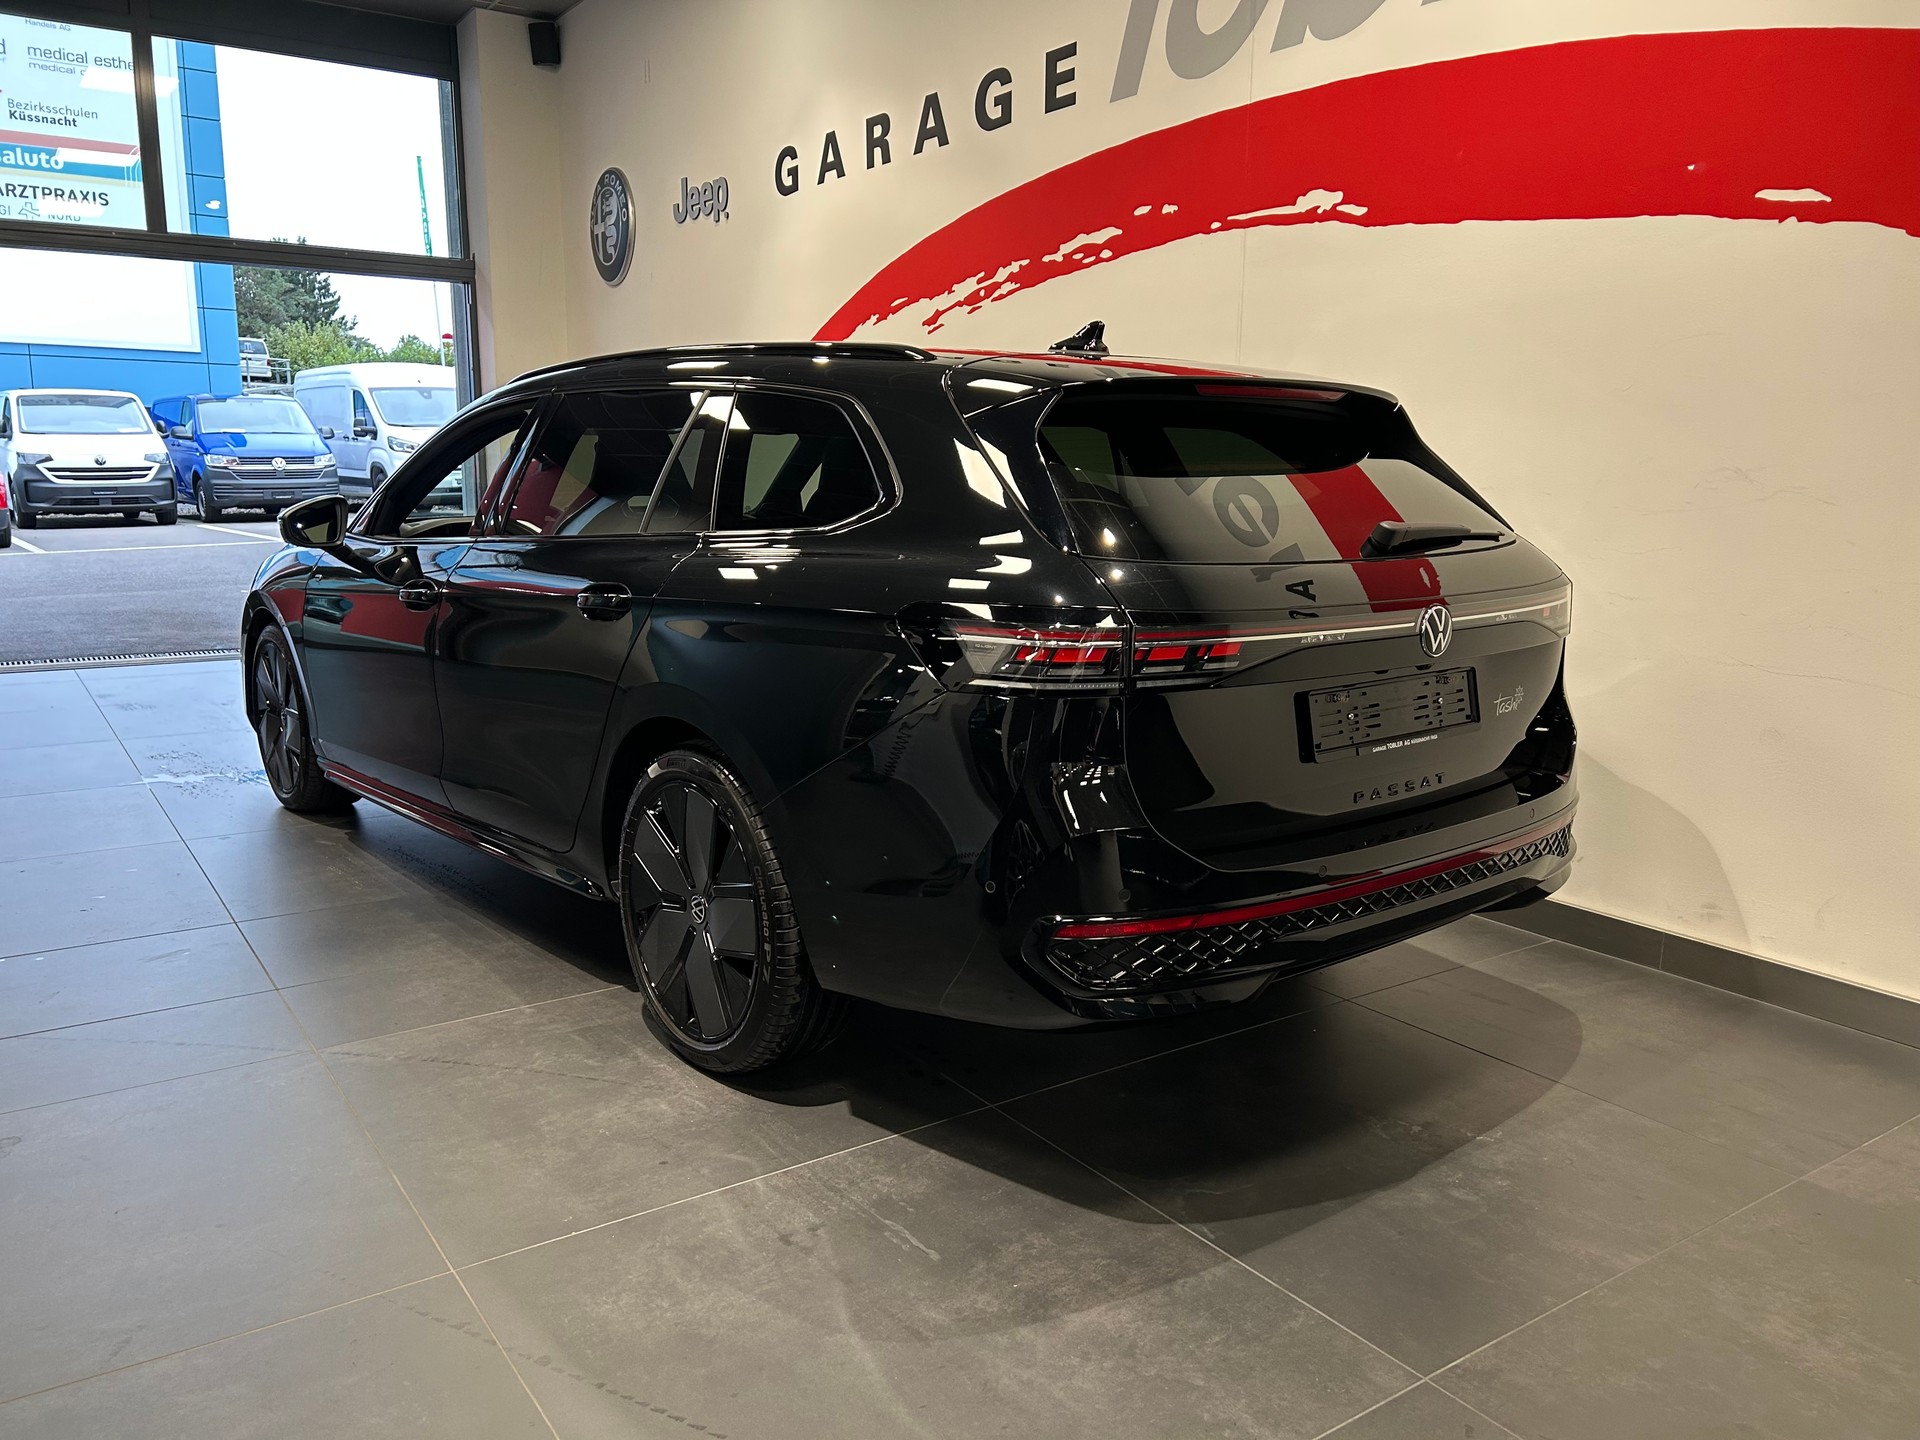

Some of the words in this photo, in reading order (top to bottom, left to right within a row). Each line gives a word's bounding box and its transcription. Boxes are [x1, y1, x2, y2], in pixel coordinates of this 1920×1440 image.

[25, 18, 57, 29] Handels
[27, 45, 88, 64] medical
[28, 62, 76, 75] medical
[7, 98, 98, 119] Bezirksschulen
[8, 109, 78, 128] Küssnacht
[774, 40, 1079, 197] GARAGE
[603, 173, 629, 222] ROMEO
[672, 176, 729, 224] Jeep
[1352, 771, 1446, 804] PASSAT
